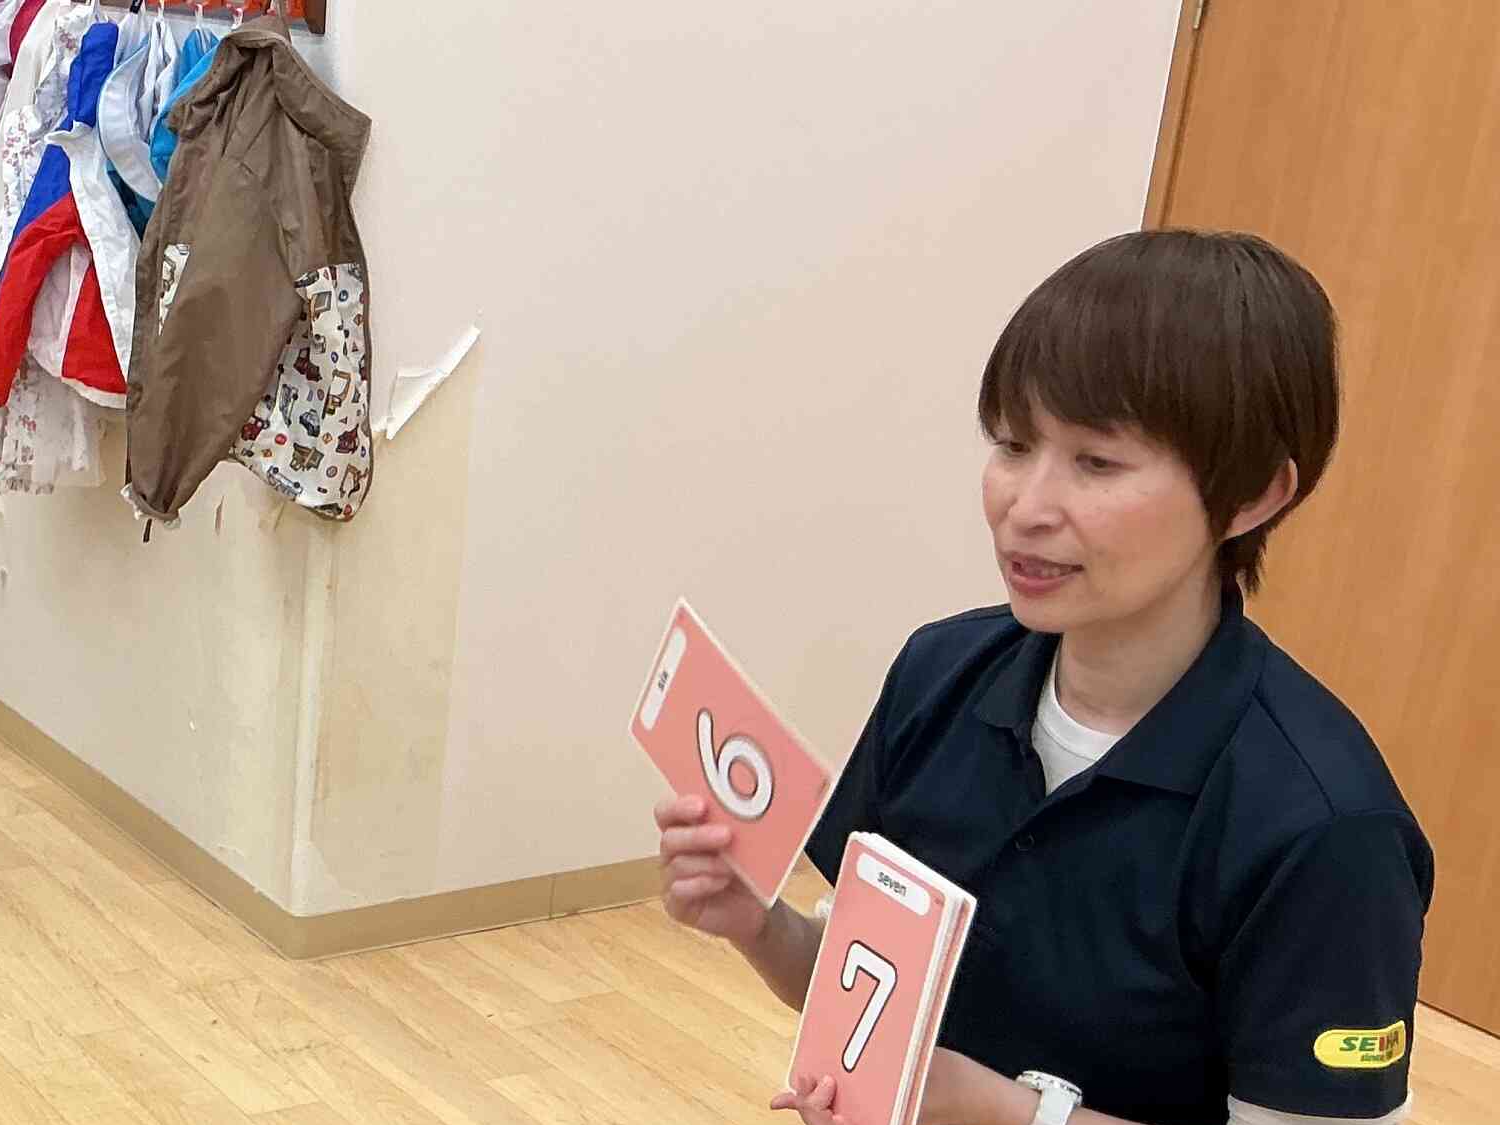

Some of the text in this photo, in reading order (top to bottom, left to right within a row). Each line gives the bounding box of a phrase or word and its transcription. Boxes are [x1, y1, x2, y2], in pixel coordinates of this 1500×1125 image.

[697, 708, 773, 820] 6
[877, 871, 907, 897] seven
[841, 940, 897, 1073] 7
